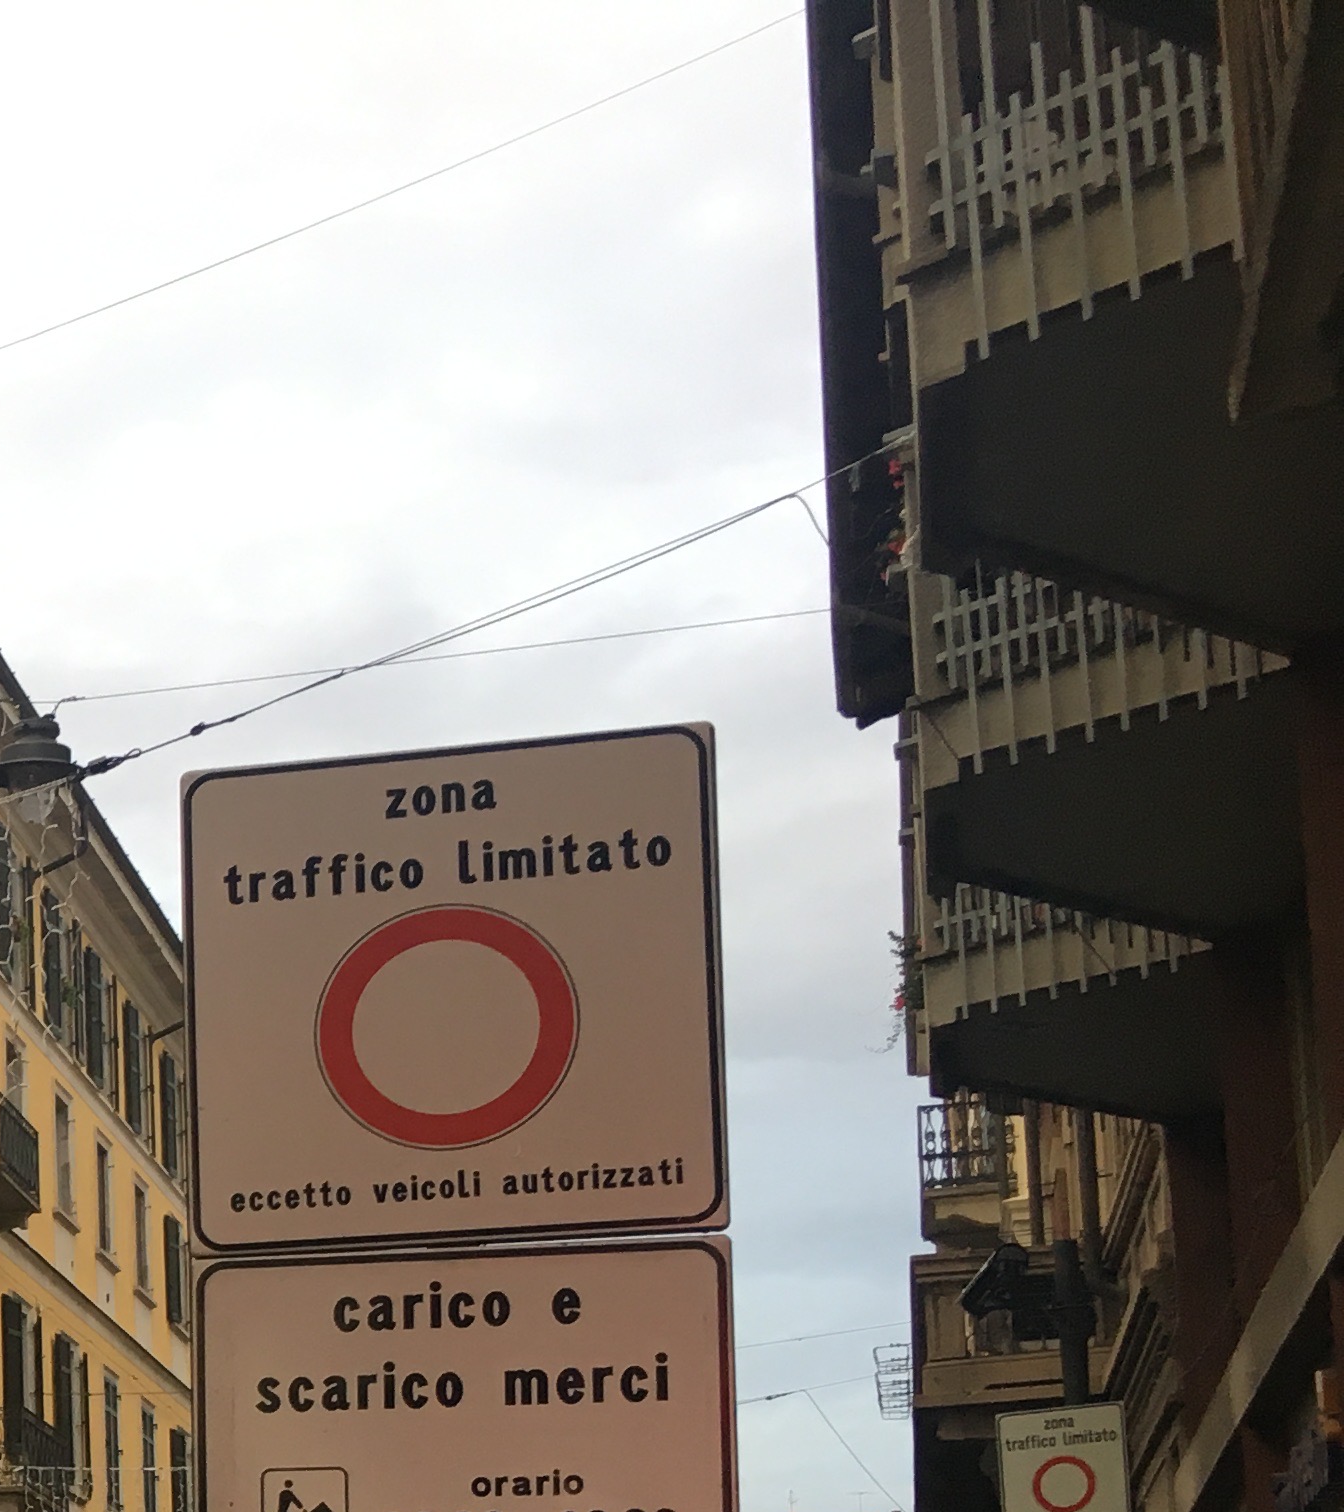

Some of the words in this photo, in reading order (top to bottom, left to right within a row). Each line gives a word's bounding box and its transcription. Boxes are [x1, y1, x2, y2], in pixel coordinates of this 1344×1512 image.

[385, 779, 497, 819] zona
[224, 855, 424, 905] traffico
[458, 828, 672, 884] limitato
[230, 1182, 352, 1213] eccetto
[373, 1170, 481, 1203] veicoli
[502, 1157, 685, 1196] autorizzati
[334, 1281, 511, 1332] carico
[552, 1287, 582, 1324] e
[255, 1361, 464, 1414] scarico
[504, 1352, 669, 1405] merci
[1006, 1435, 1057, 1451] traffico
[1062, 1428, 1117, 1445] limitato
[1044, 1417, 1074, 1430] zona
[470, 1469, 584, 1498] orario
